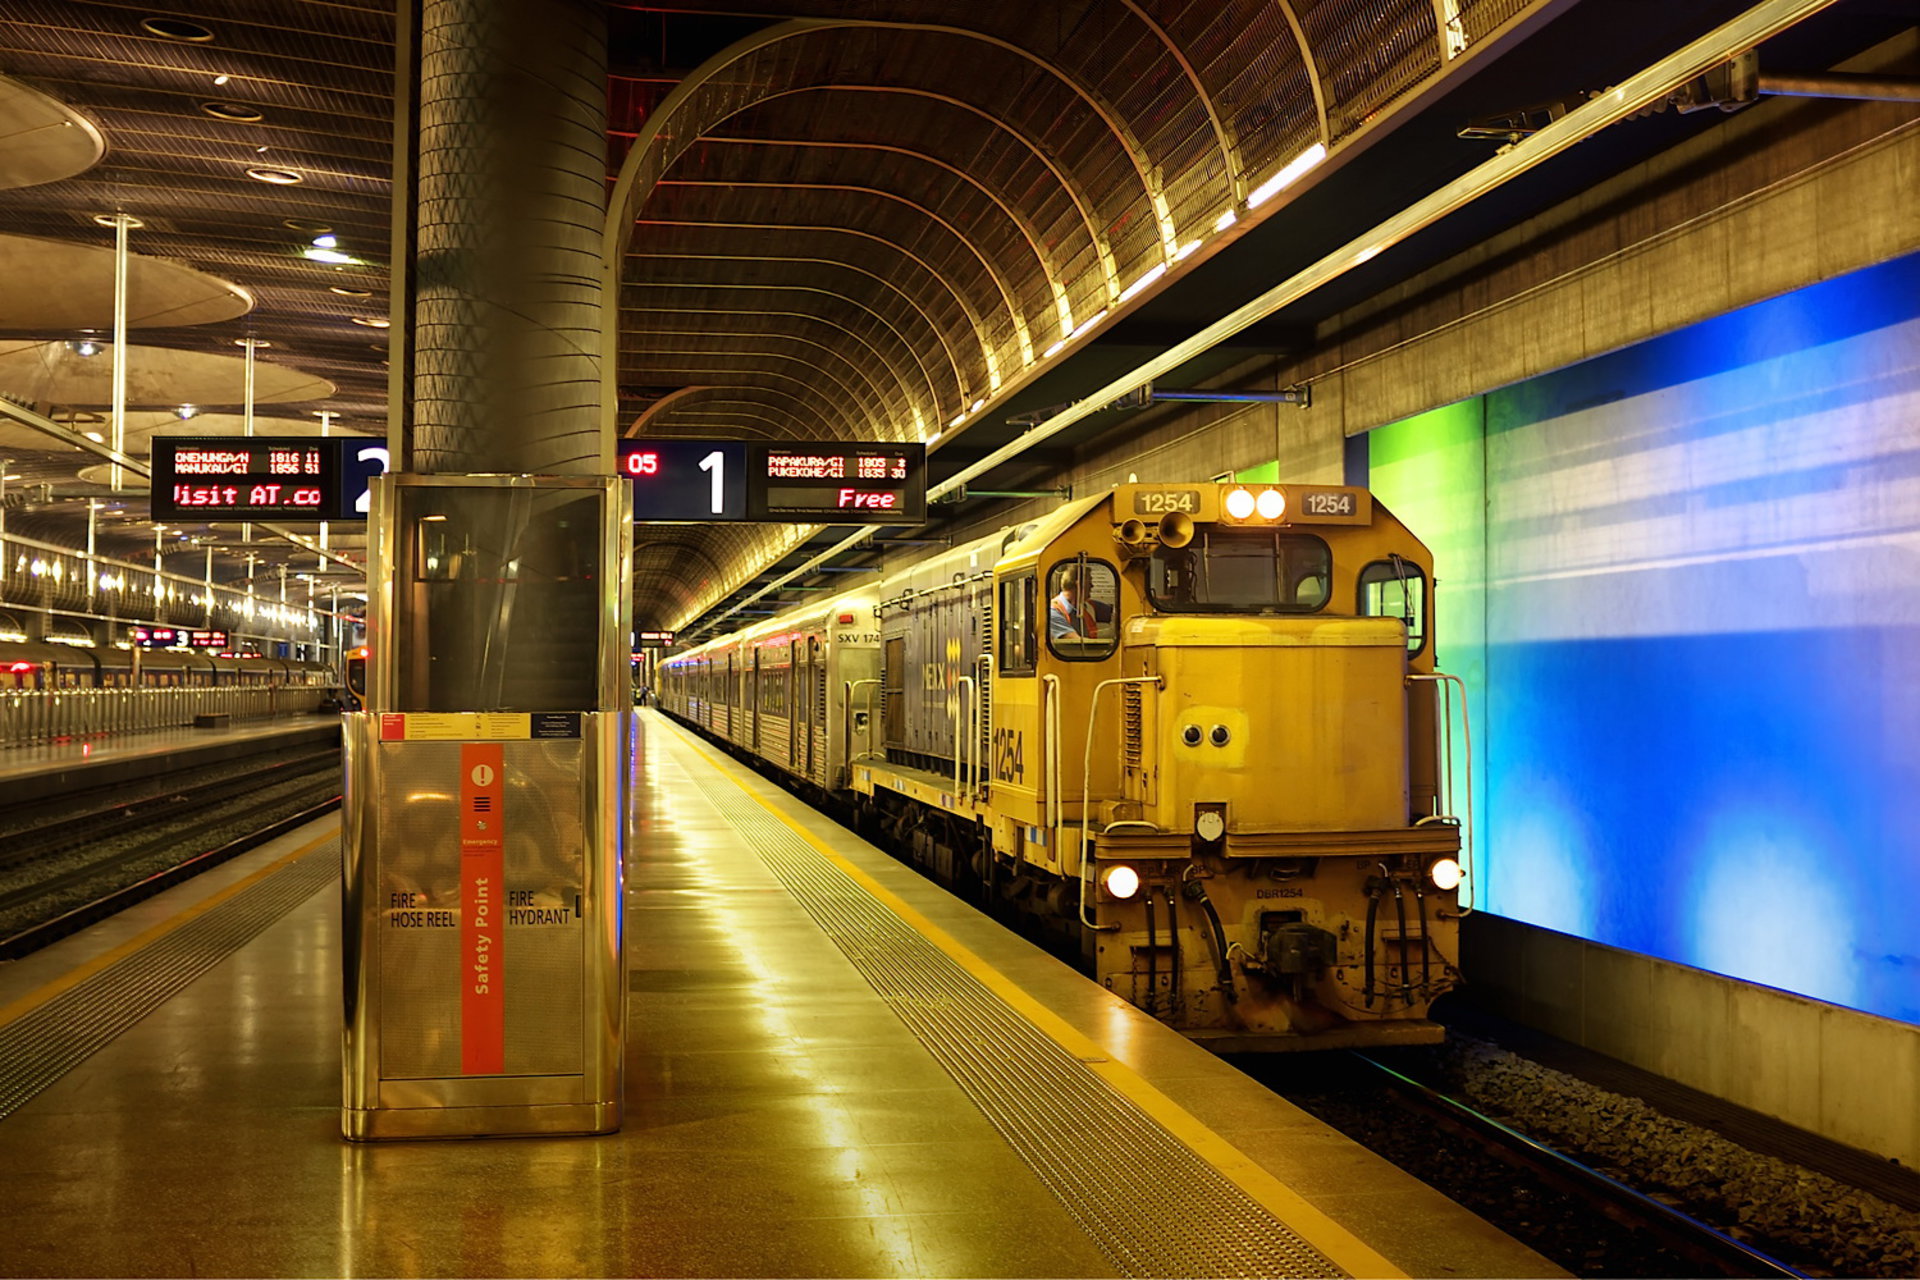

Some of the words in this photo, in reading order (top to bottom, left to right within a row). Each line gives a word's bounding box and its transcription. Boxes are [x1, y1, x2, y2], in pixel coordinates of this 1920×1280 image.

[270, 452, 300, 463] 1816
[306, 452, 320, 463] 11
[628, 453, 658, 474] 05
[858, 457, 886, 467] 1805
[270, 463, 300, 474] 1856
[305, 463, 320, 474] 51
[858, 468, 886, 479] 1835
[890, 468, 906, 479] 30
[698, 451, 724, 514] 1
[838, 488, 896, 508] Free
[1141, 494, 1193, 512] 1254
[1308, 495, 1350, 513] 1254
[176, 630, 188, 647] 3
[838, 634, 859, 643] SXV
[992, 727, 1024, 785] 1254
[462, 839, 498, 847] Emergency
[391, 893, 416, 909] FIRE
[474, 877, 489, 928] Point
[509, 891, 534, 906] FIRE
[391, 912, 423, 928] HOSE
[427, 912, 456, 927] REEL
[509, 909, 570, 925] HYDRANT
[474, 935, 491, 995] Safety
